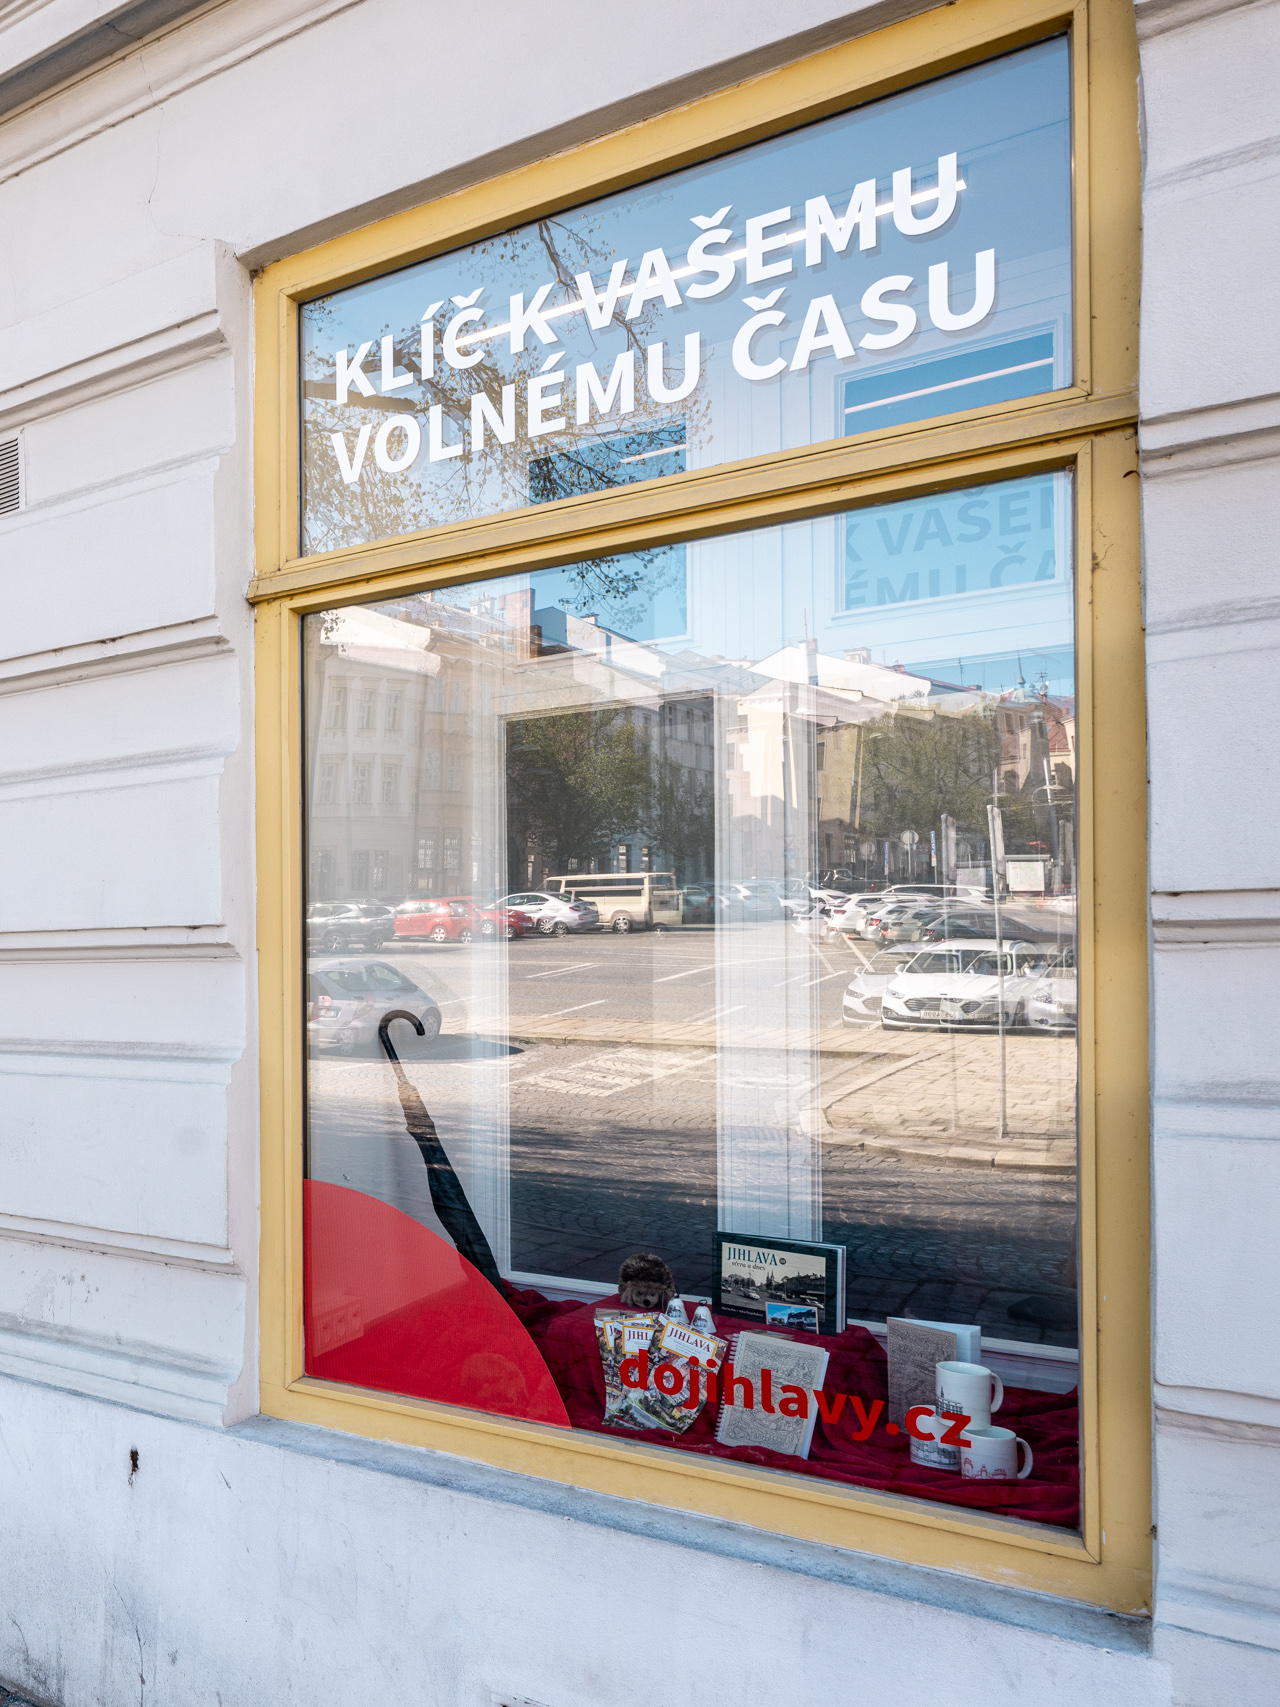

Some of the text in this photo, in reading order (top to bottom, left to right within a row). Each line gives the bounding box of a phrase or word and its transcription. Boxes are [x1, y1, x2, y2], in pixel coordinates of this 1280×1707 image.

[335, 153, 959, 405] KLÍČ K VAŠEMU
[331, 249, 995, 485] VOLNÉMU ČASU
[727, 1247, 778, 1266] JIHLAVA
[752, 1263, 766, 1271] dnes
[667, 1328, 711, 1353] JIHLAVA
[619, 1348, 972, 1448] dojihlavy.cz
